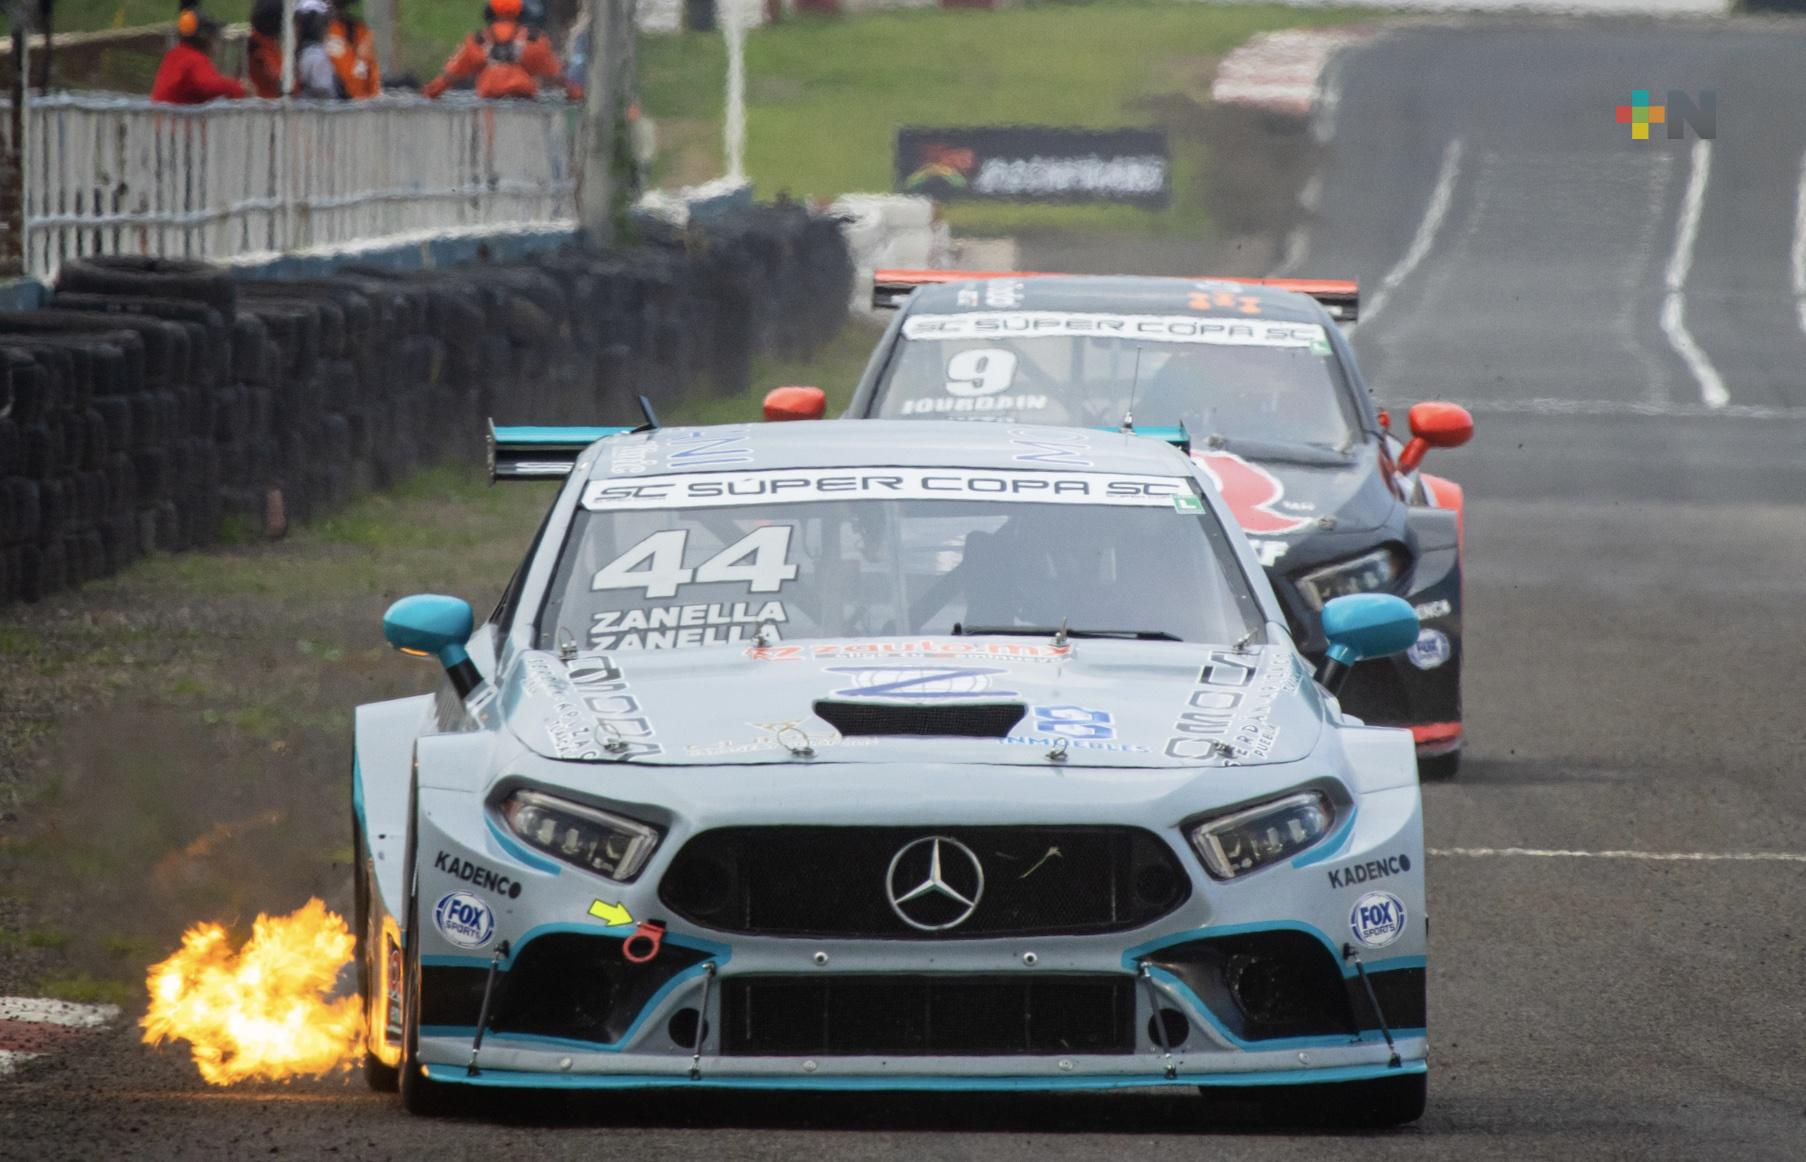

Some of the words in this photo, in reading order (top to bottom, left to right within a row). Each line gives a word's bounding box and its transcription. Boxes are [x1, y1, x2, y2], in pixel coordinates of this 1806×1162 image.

[944, 348, 1018, 398] 9
[595, 483, 677, 500] SC
[688, 475, 904, 498] SÚPER
[921, 477, 1090, 495] COPA
[1106, 481, 1181, 497] SC
[590, 525, 799, 600] 44
[590, 601, 789, 634] ZANELLA
[588, 624, 782, 651] ZANELLA
[448, 899, 485, 930] FOX
[1360, 902, 1393, 930] FOX
[446, 920, 481, 939] SPORTS
[1363, 923, 1396, 938] SPORTS
